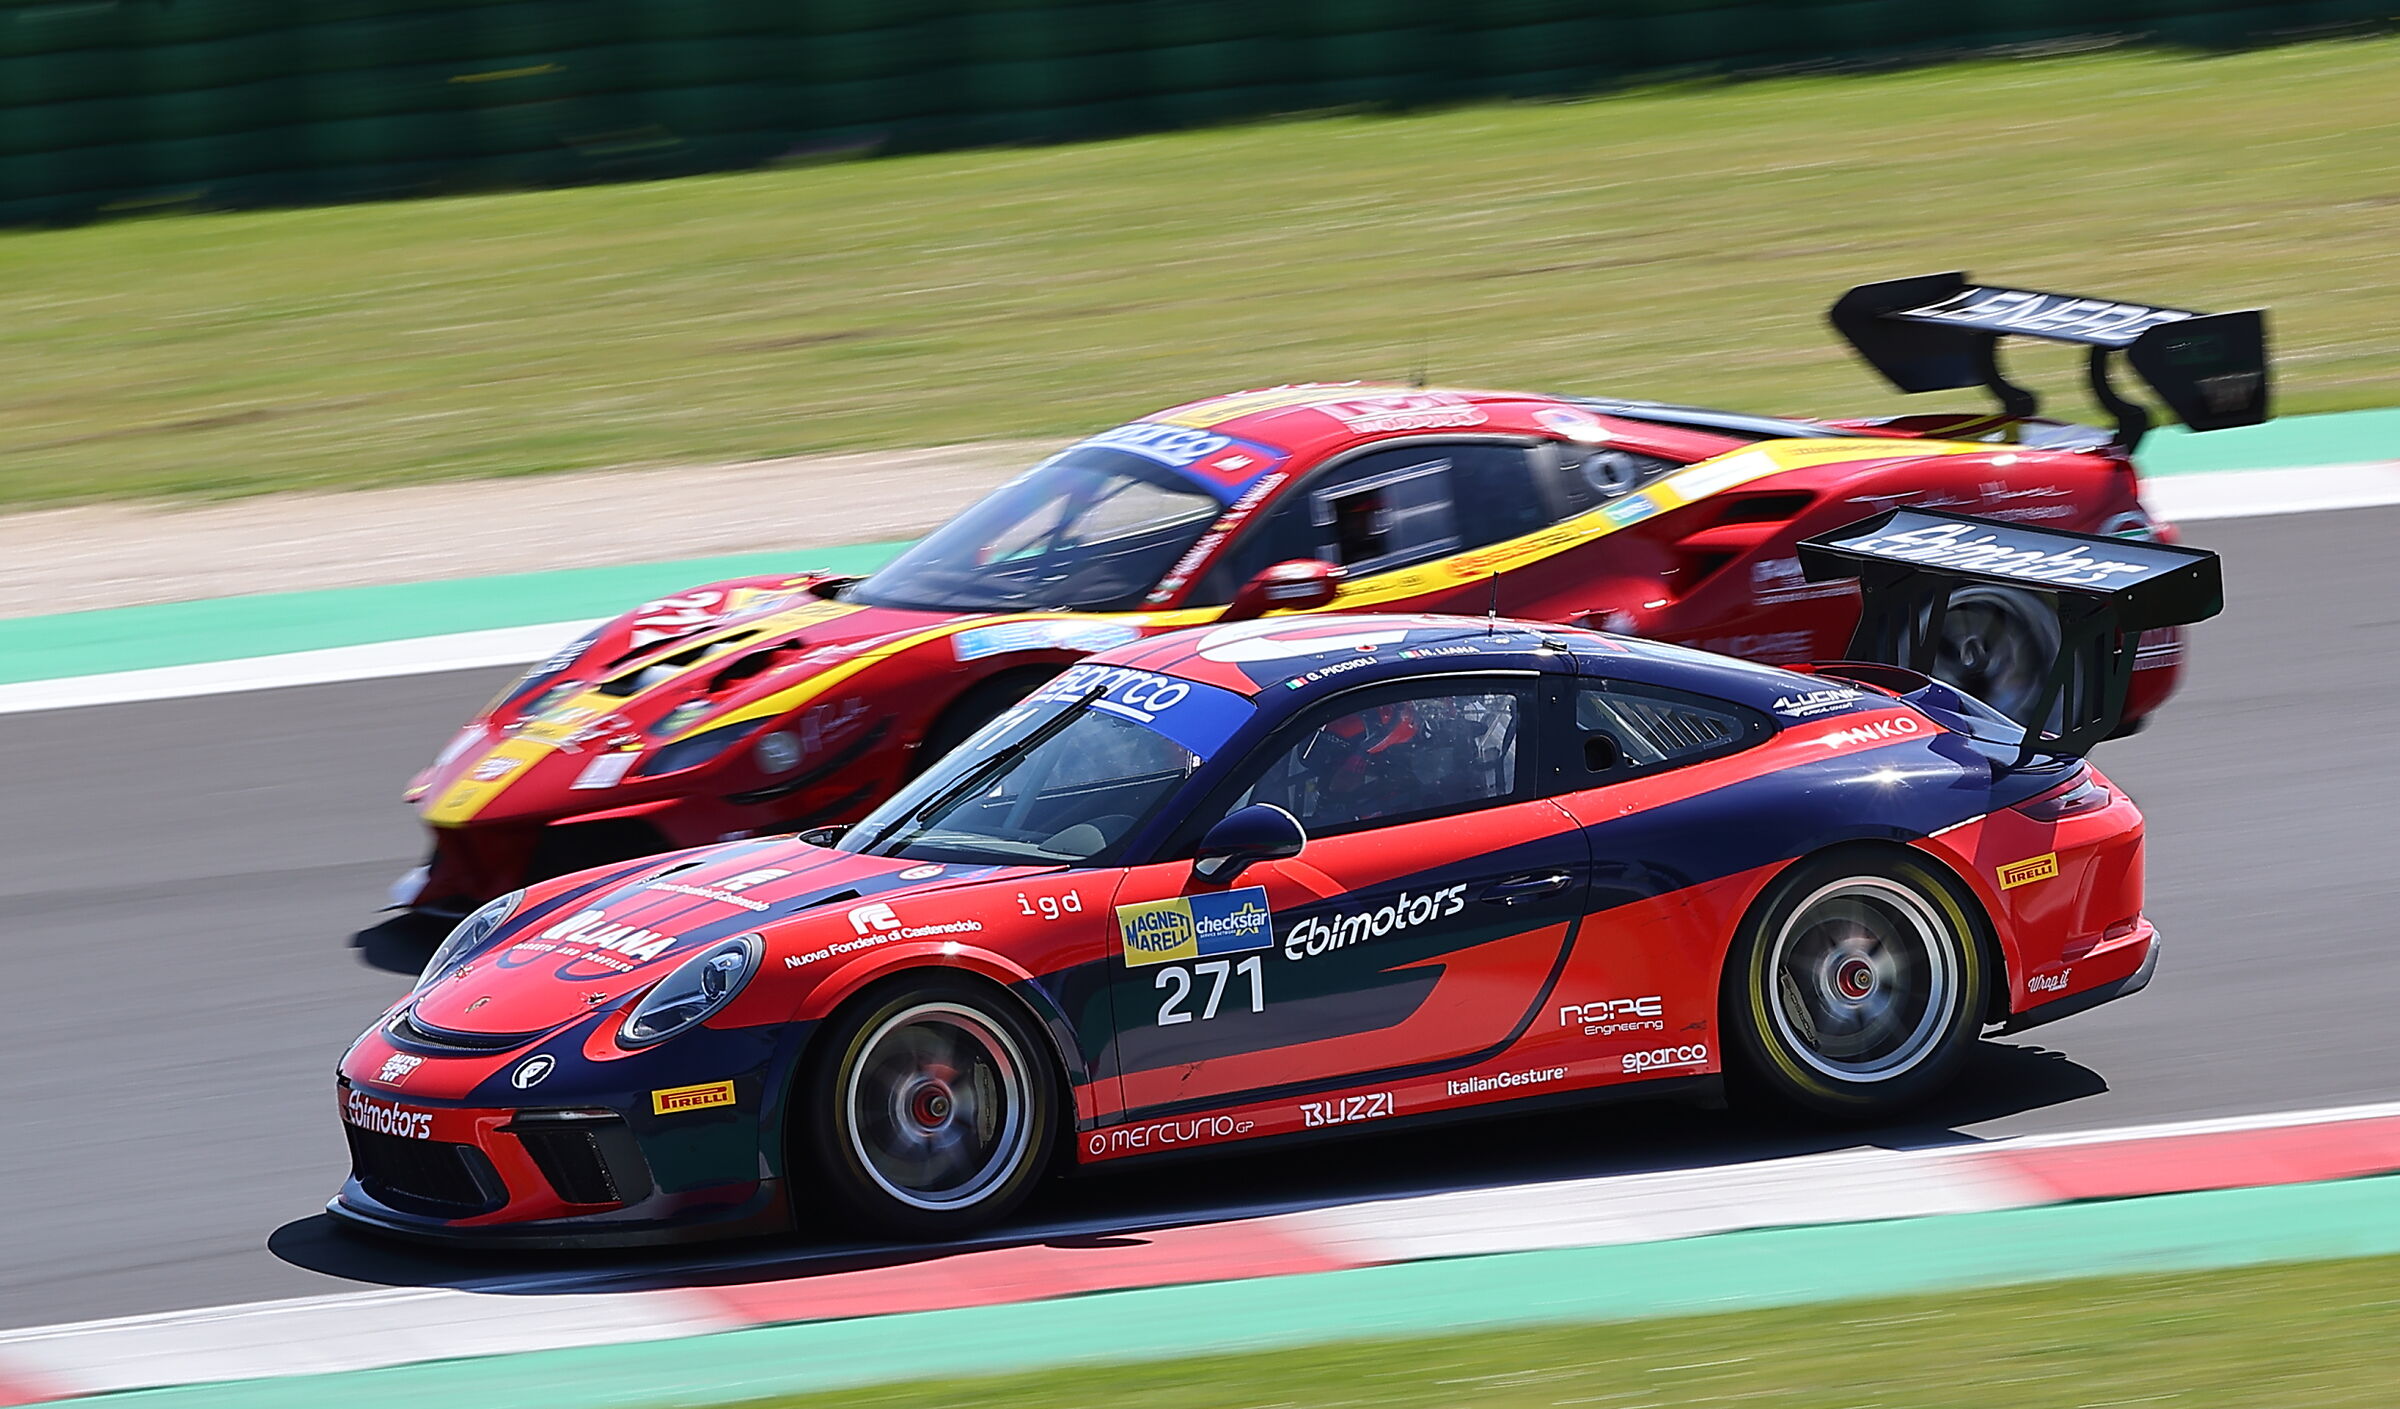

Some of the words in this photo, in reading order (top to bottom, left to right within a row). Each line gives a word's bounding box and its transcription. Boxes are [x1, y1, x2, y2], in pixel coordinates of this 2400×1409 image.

[1438, 646, 1480, 656] LIANA
[1322, 657, 1377, 677] PICCIOLI
[2003, 858, 2053, 885] PIRELLI
[1017, 889, 1083, 920] igd
[1196, 910, 1268, 934] checkstar
[1284, 883, 1467, 961] Ebimotors
[784, 948, 829, 969] Nuova
[830, 933, 887, 956] Fonderia
[888, 928, 900, 941] di
[901, 919, 982, 939] Castenedolo
[1155, 956, 1264, 1026] 271
[2028, 974, 2059, 993] Wrap
[1583, 1020, 1663, 1036] Engineering
[382, 1062, 413, 1075] SPRI
[388, 1053, 423, 1067] AUTO
[1622, 1043, 1708, 1074] sparco
[1447, 1067, 1564, 1096] ItalianGesture
[661, 1086, 727, 1109] PIRELLI
[1299, 1091, 1395, 1127] BUZZI
[349, 1089, 433, 1139] Ebimotors
[1111, 1115, 1234, 1150] MERCURIO
[1236, 1121, 1255, 1133] GP
